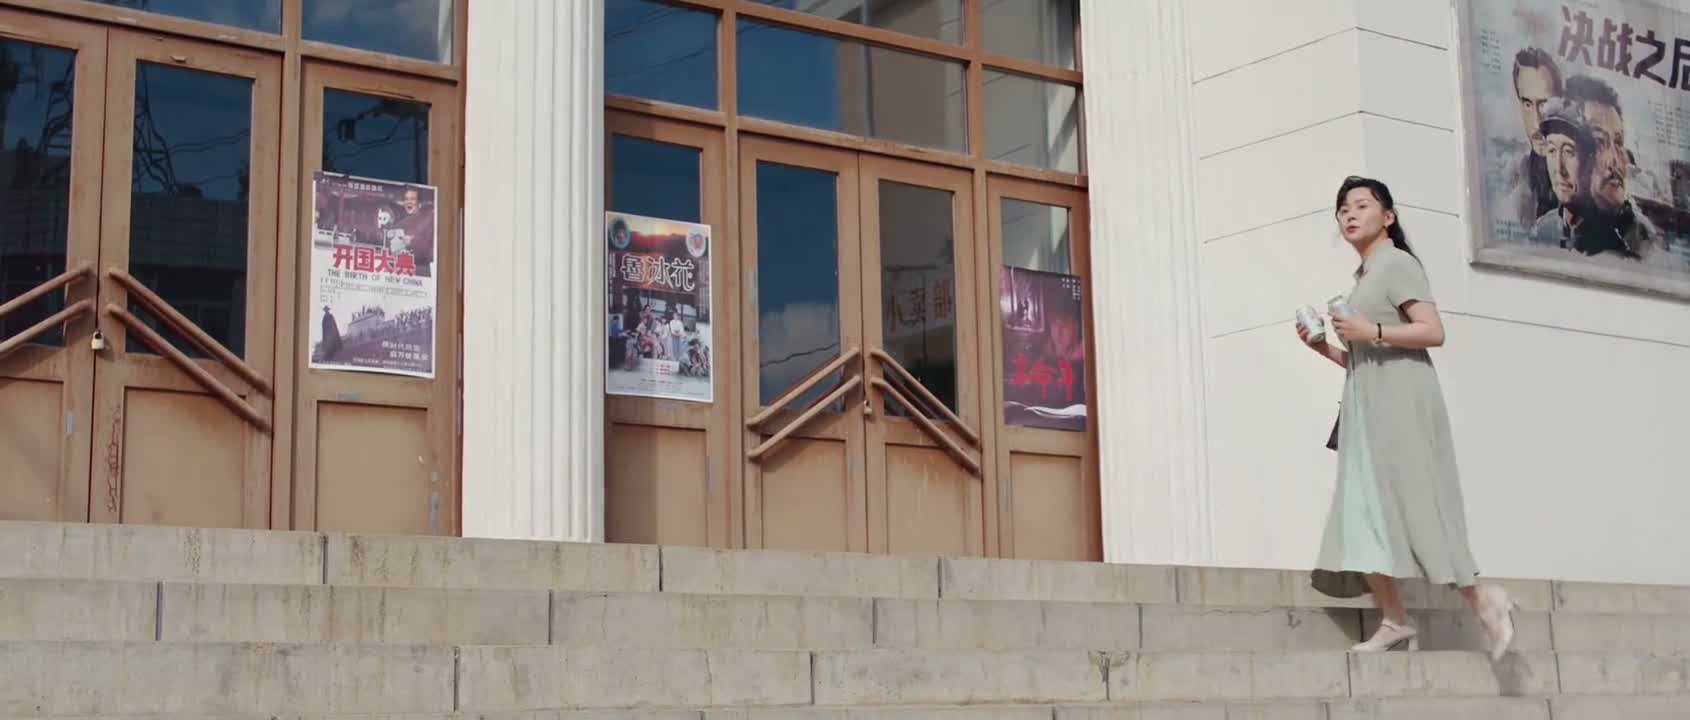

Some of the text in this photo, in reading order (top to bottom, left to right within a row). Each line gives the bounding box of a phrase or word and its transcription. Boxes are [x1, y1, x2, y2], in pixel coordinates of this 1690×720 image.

[333, 243, 416, 277] 开国大典
[328, 269, 423, 286] THE BIRTH OF NEW CHINA
